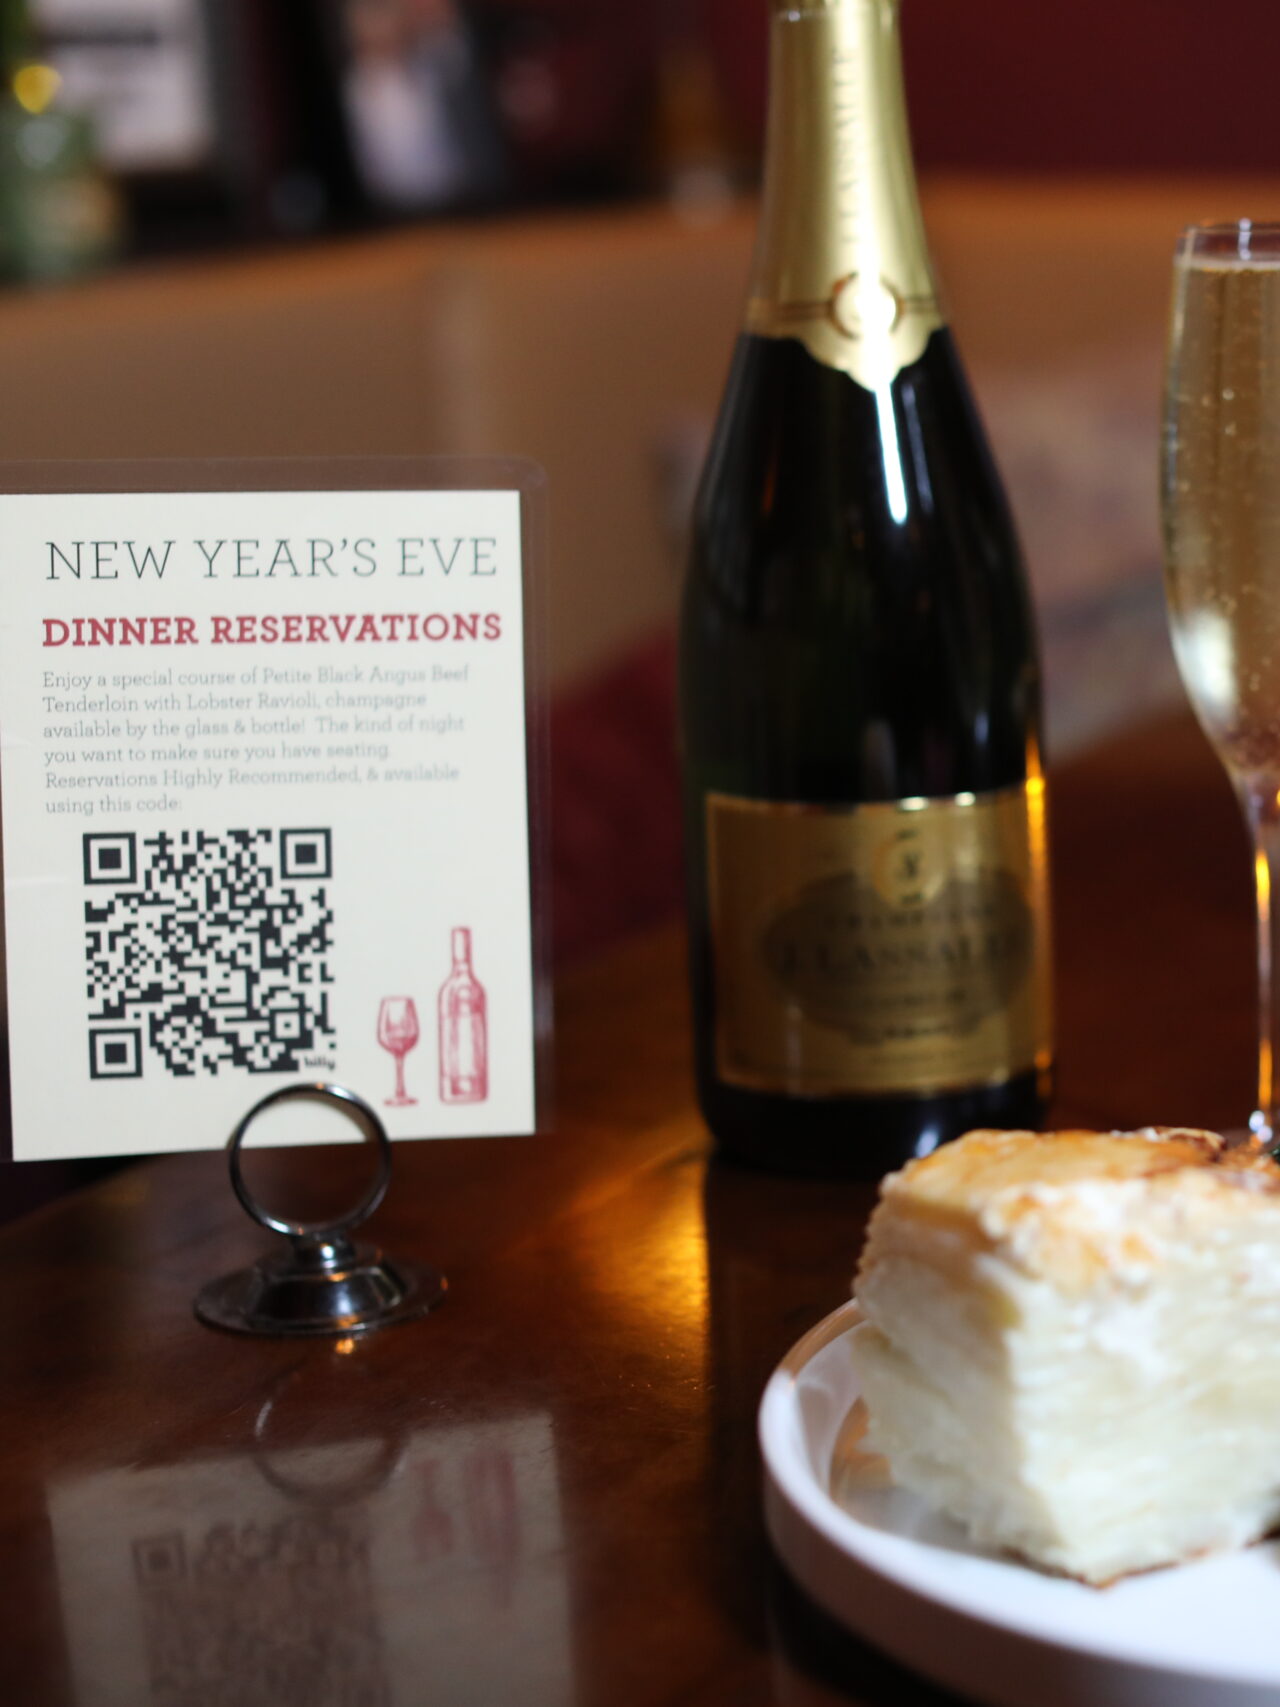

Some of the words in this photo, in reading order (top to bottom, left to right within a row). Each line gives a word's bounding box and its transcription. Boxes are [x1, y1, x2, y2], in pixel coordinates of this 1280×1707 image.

[44, 540, 177, 580] NEW
[193, 537, 378, 578] YEAR'S
[395, 537, 499, 577] EVE
[41, 617, 200, 647] DINNER
[209, 613, 502, 643] RESERVATIONS
[43, 671, 92, 690] Enjoy
[97, 675, 107, 687] a
[112, 668, 174, 690] special
[178, 672, 236, 686] course
[240, 665, 258, 685] of
[263, 667, 312, 685] Petite
[317, 665, 364, 684] Black
[369, 665, 426, 686] Angus
[431, 663, 469, 682] Beef
[43, 694, 139, 713] Tenderloin
[144, 692, 181, 711] with
[187, 692, 253, 711] Lobster
[257, 691, 321, 711] Ravioli,
[325, 690, 427, 711] champagne
[43, 720, 121, 739] available
[126, 719, 147, 741] by
[152, 719, 181, 736] the
[185, 718, 230, 740] glass
[233, 721, 246, 735] &
[313, 715, 350, 734] The
[353, 714, 393, 733] kind
[396, 713, 415, 732] of
[419, 712, 465, 734] night
[43, 751, 76, 768] you
[81, 749, 123, 762] want
[128, 749, 146, 761] to
[150, 743, 199, 761] make
[203, 748, 240, 760] sure
[244, 747, 276, 762] you
[281, 740, 322, 759] have
[45, 772, 159, 789] Reservations
[163, 769, 223, 790] Highly
[228, 764, 363, 785] Recommended,
[366, 769, 380, 783] &
[384, 762, 460, 782] available
[45, 798, 95, 816] using
[99, 794, 133, 812] this
